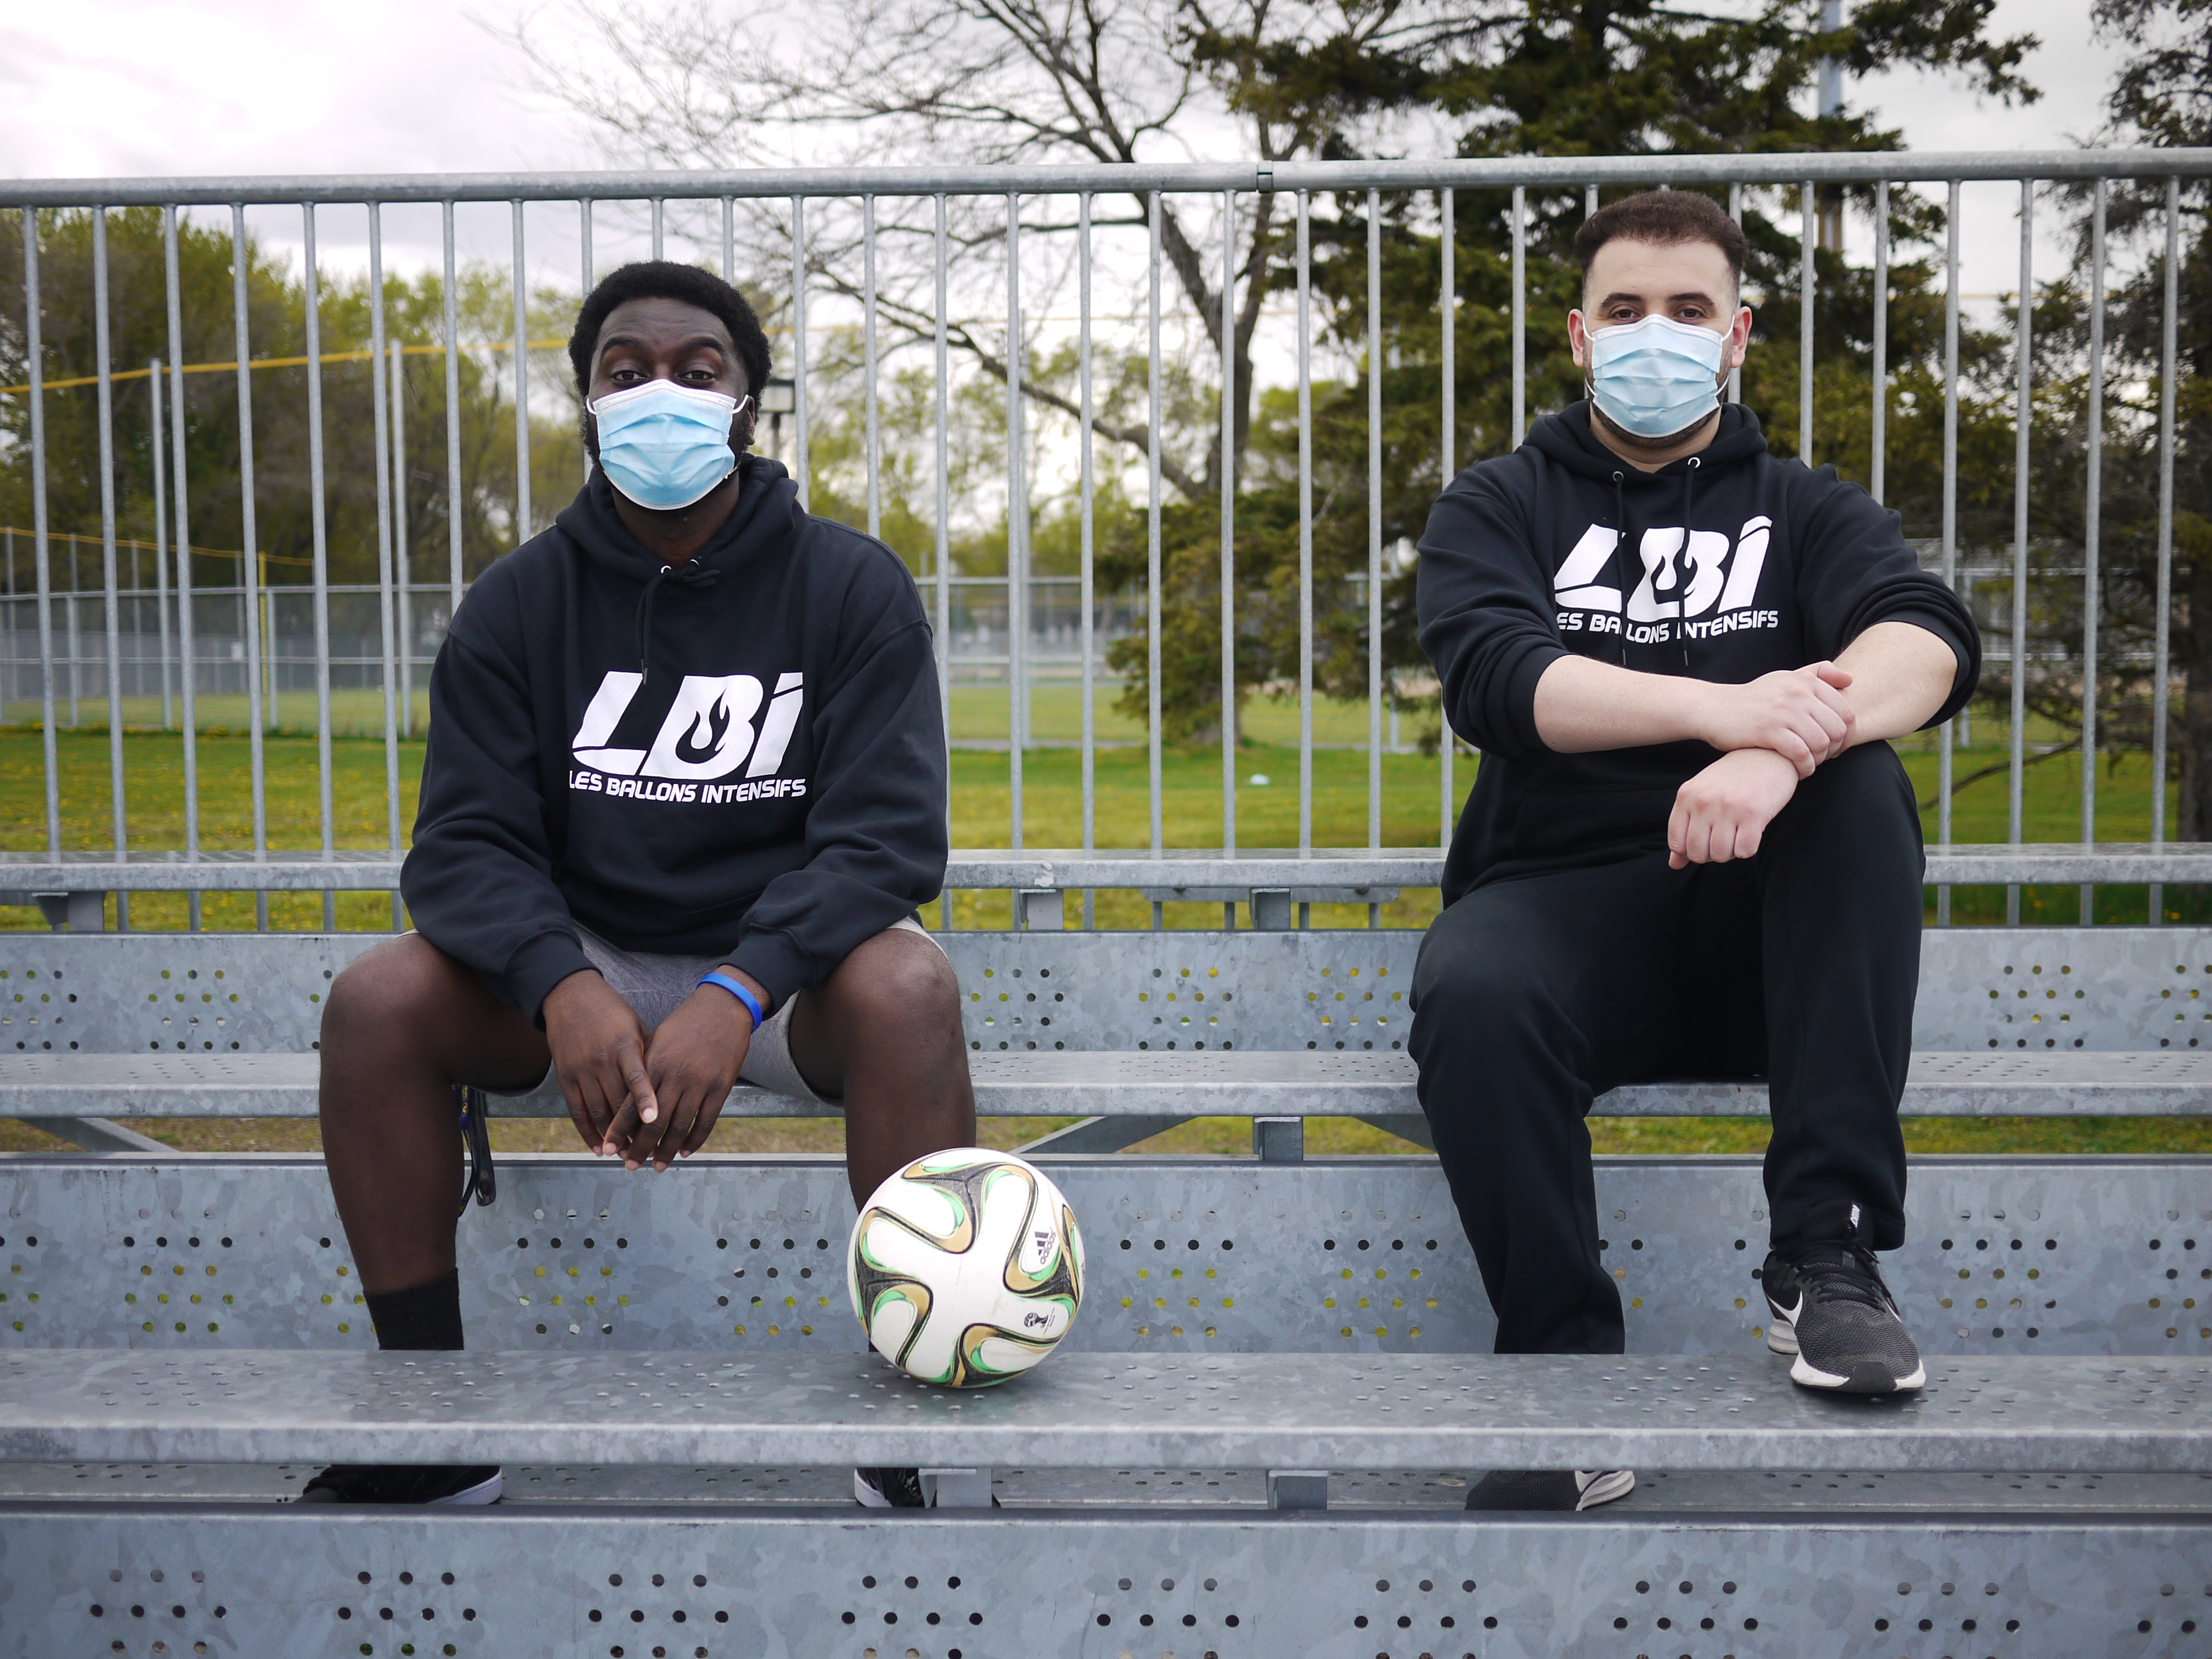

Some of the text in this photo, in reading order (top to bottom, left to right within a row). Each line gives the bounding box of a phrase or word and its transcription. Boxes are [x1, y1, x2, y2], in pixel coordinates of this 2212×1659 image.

[1557, 612, 1584, 630] ES
[1589, 614, 1670, 644] BALONS
[569, 770, 807, 804] LES BALLONS INTENSIFS
[1040, 1230, 1056, 1265] adidas
